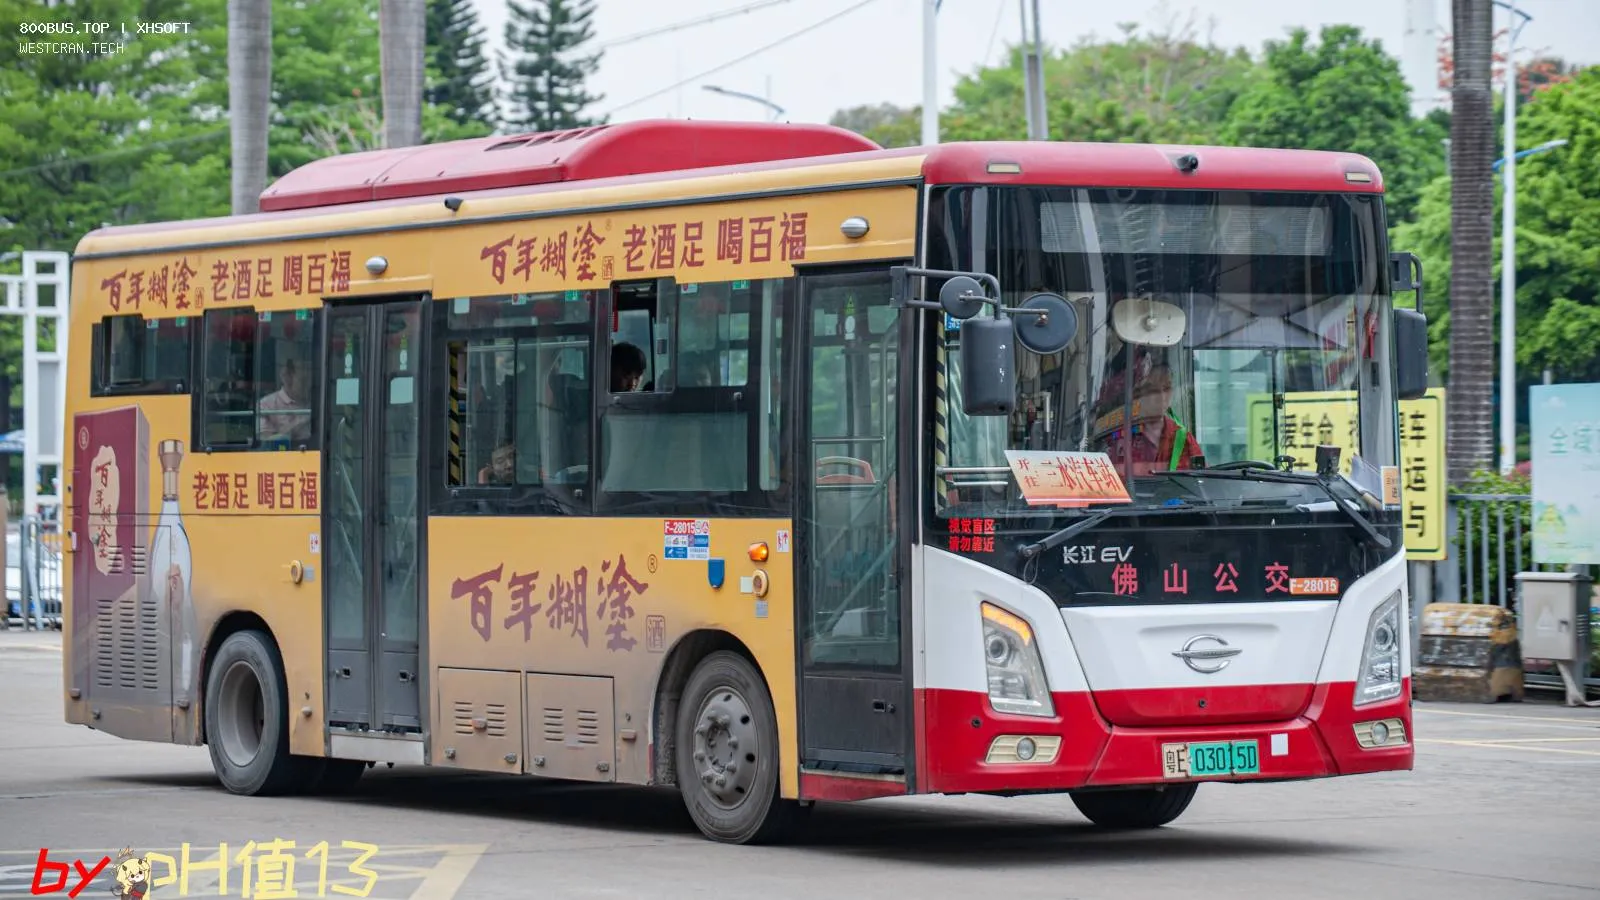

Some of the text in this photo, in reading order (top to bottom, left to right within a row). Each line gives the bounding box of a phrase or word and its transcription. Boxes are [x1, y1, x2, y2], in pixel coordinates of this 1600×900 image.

[622, 222, 705, 273] 老酒足
[716, 211, 808, 264] 喝百福
[210, 258, 273, 302] 老酒足
[282, 250, 352, 296] 喝百福
[192, 470, 318, 510] 老酒足 喝百福
[665, 521, 695, 534] F-28015
[948, 518, 995, 534] 视觉盲区
[948, 536, 995, 552] 请勿靠近
[1063, 546, 1133, 564] 长江 EV
[1111, 562, 1289, 595] 佛山公交
[1290, 579, 1337, 593] F-28015
